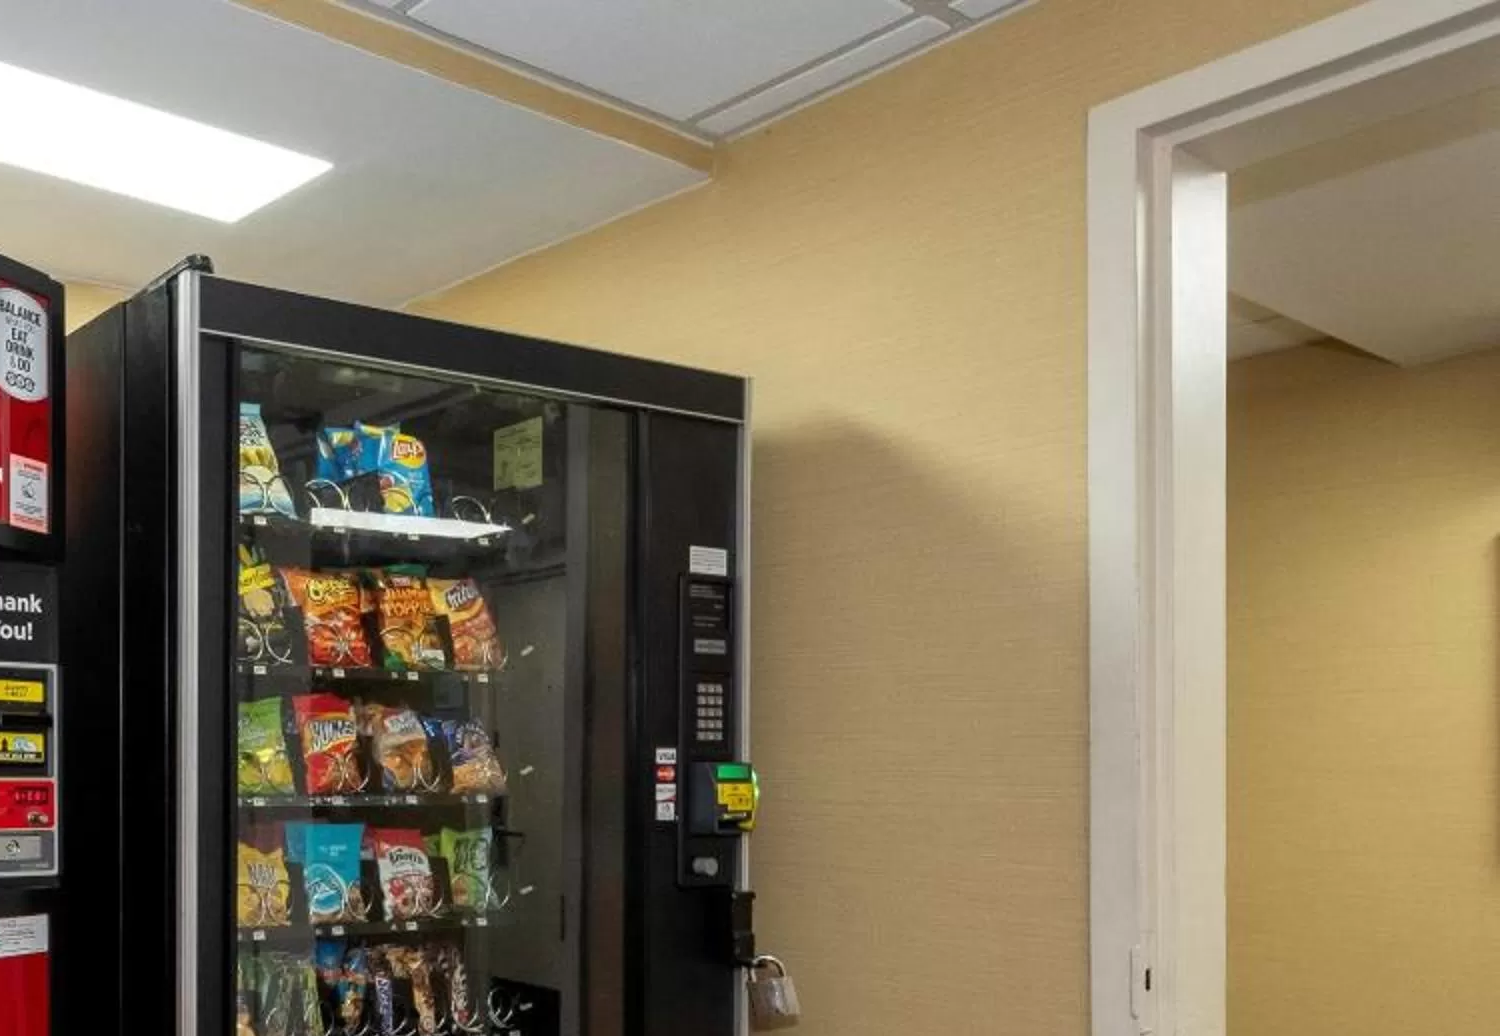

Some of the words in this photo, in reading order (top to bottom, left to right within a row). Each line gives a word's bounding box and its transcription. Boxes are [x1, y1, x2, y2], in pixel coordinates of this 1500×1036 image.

[0, 298, 42, 328] BALANCE
[11, 327, 29, 344] EAT
[17, 357, 31, 373] DO
